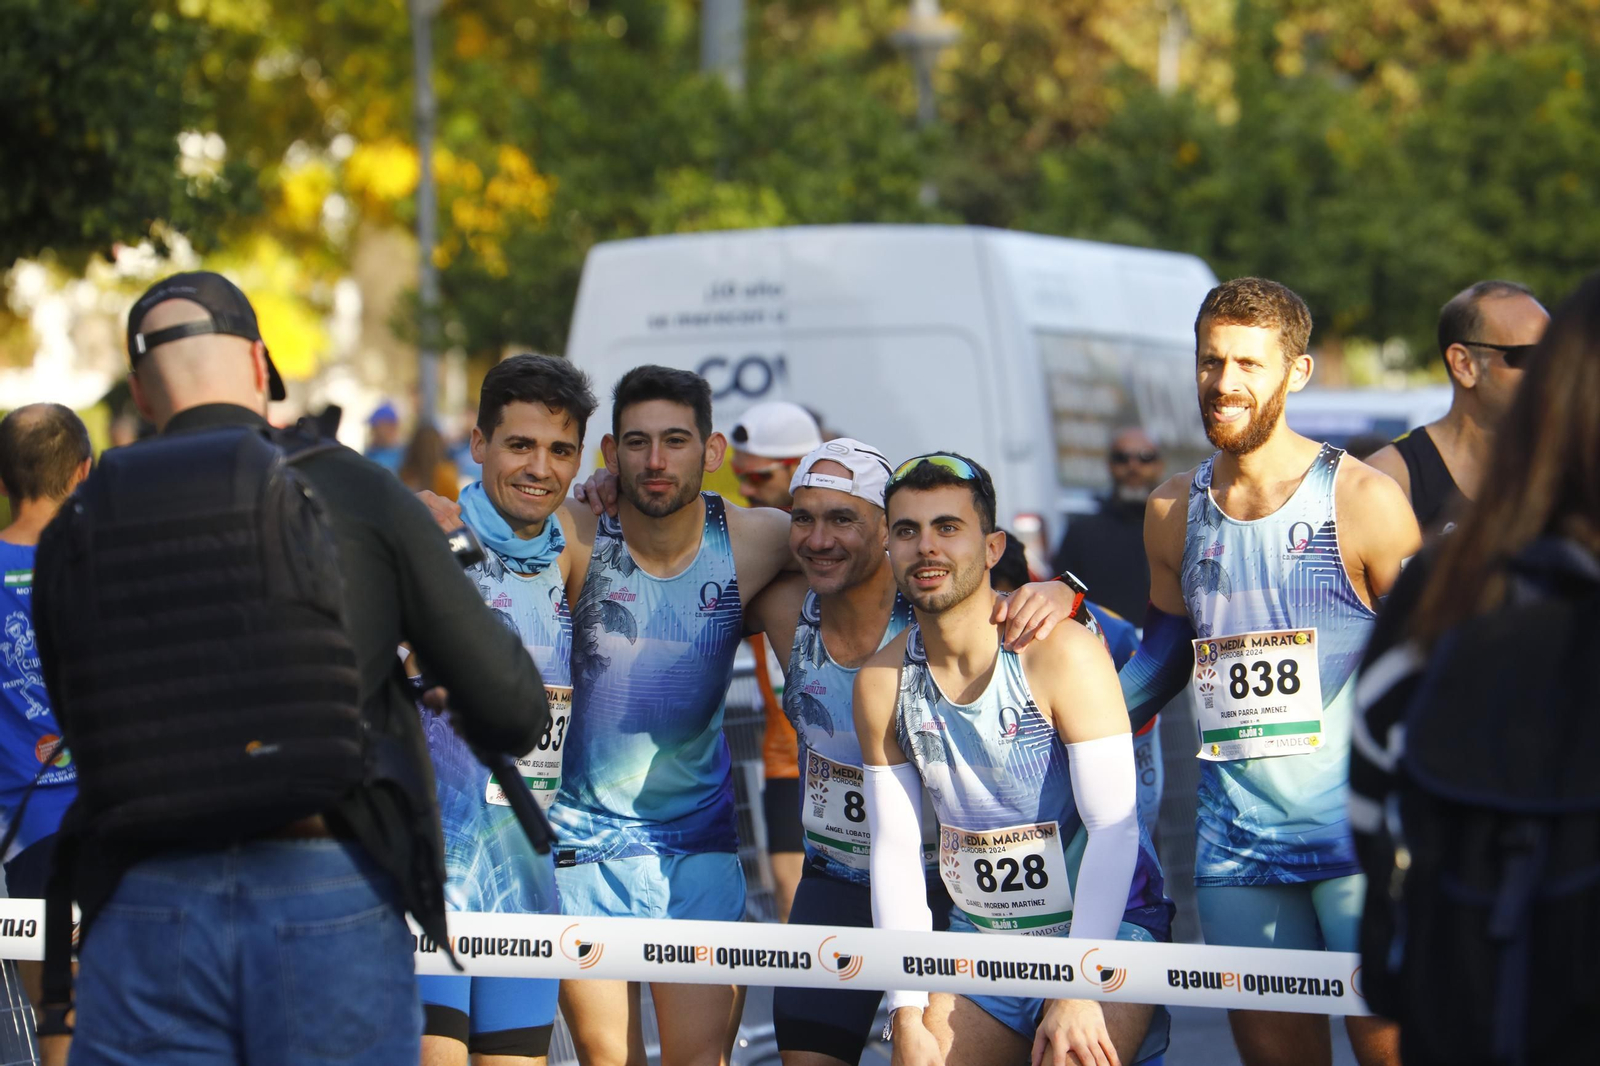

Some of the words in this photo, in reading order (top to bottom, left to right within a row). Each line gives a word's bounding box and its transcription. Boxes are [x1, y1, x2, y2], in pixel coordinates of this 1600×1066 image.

[610, 591, 637, 602] HORIZON
[492, 599, 512, 608] HORIZN
[1220, 639, 1246, 651] MEDIA
[1229, 659, 1301, 700] 838
[546, 690, 558, 702] DIA
[1238, 708, 1258, 717] PARRA
[1260, 706, 1287, 715] JIMENEZ
[1258, 728, 1263, 737] 3
[1276, 735, 1319, 748] IMDEC
[810, 755, 830, 780] 38
[832, 767, 864, 782] MEDIA
[825, 823, 844, 834] ÁNGEL
[846, 829, 871, 839] LOBATO
[942, 830, 960, 851] 38
[992, 826, 1053, 846] MARATÓN
[852, 845, 870, 856] CAJÓ
[989, 846, 1007, 854] 2024
[973, 854, 1049, 893] 828
[966, 899, 983, 909] DANIEL
[1011, 898, 1046, 909] MARTÍNEZ
[0, 918, 37, 938] cru
[1012, 920, 1018, 929] 3
